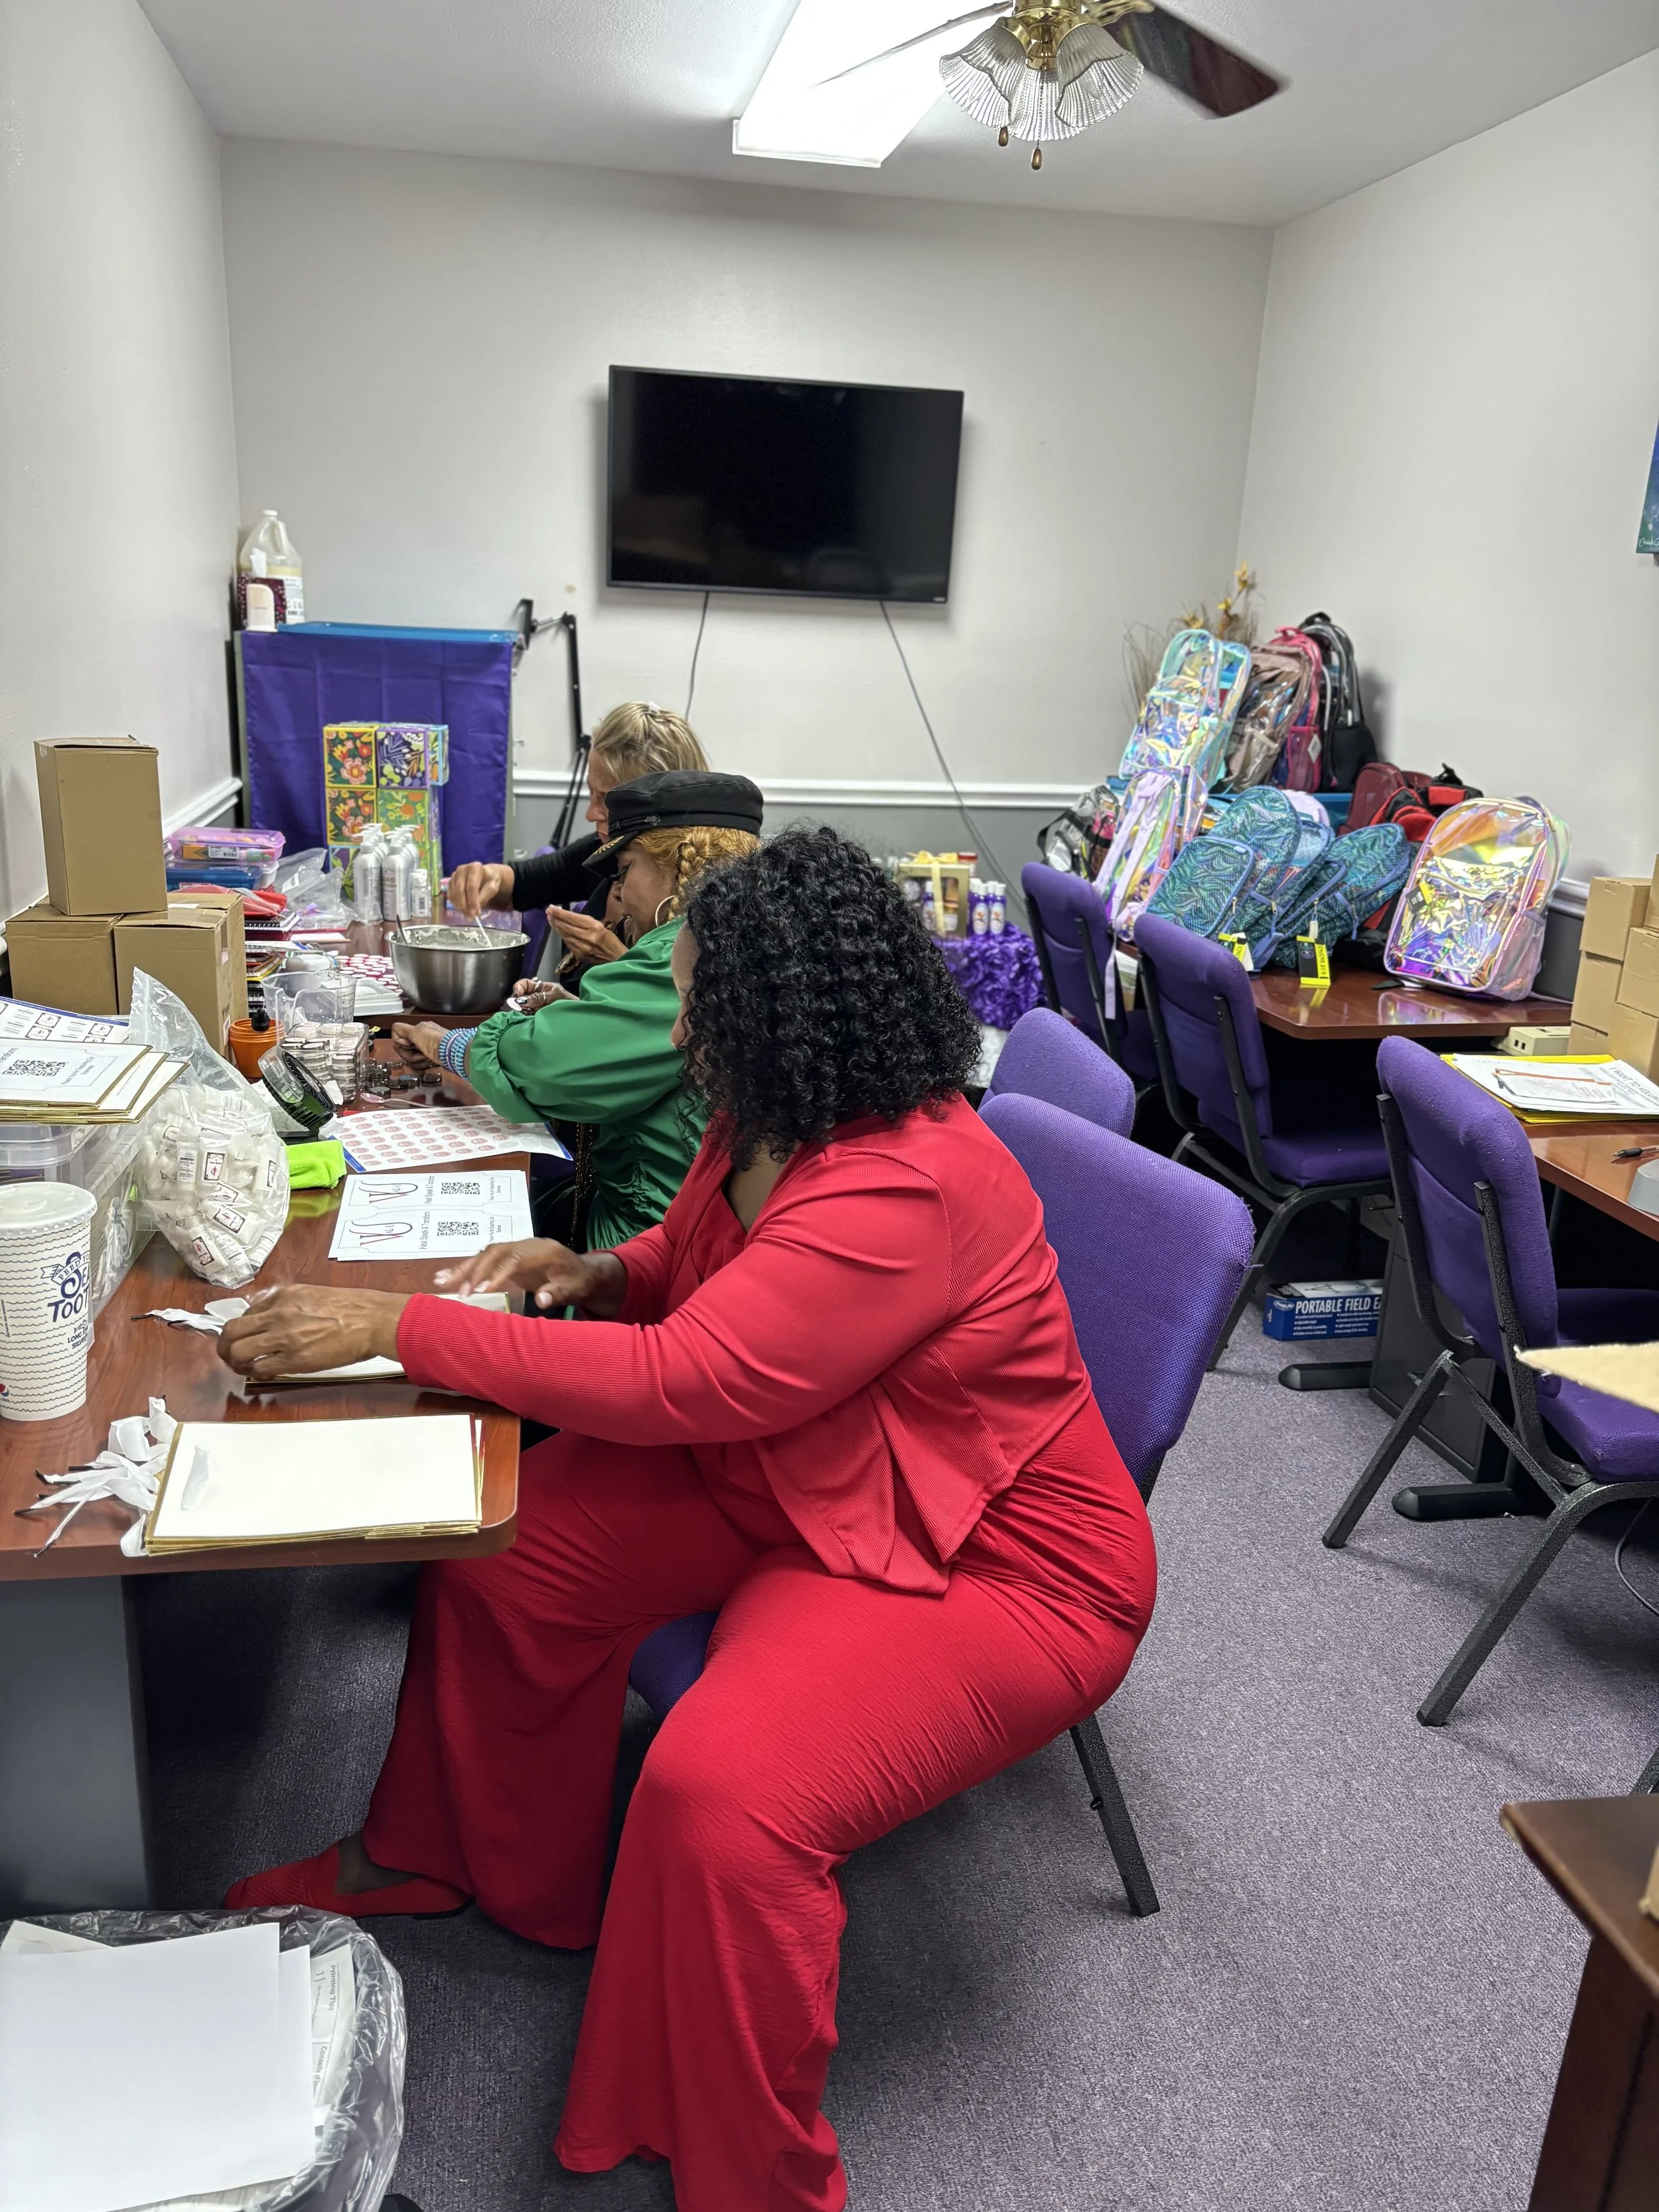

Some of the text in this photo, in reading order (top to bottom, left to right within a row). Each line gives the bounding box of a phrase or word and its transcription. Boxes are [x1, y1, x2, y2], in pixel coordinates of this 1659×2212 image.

[58, 1260, 80, 1280] FEED
[1295, 1299, 1343, 1314] PORTABLE
[1344, 1297, 1371, 1311] FIELD
[68, 1331, 82, 1343] LONG
